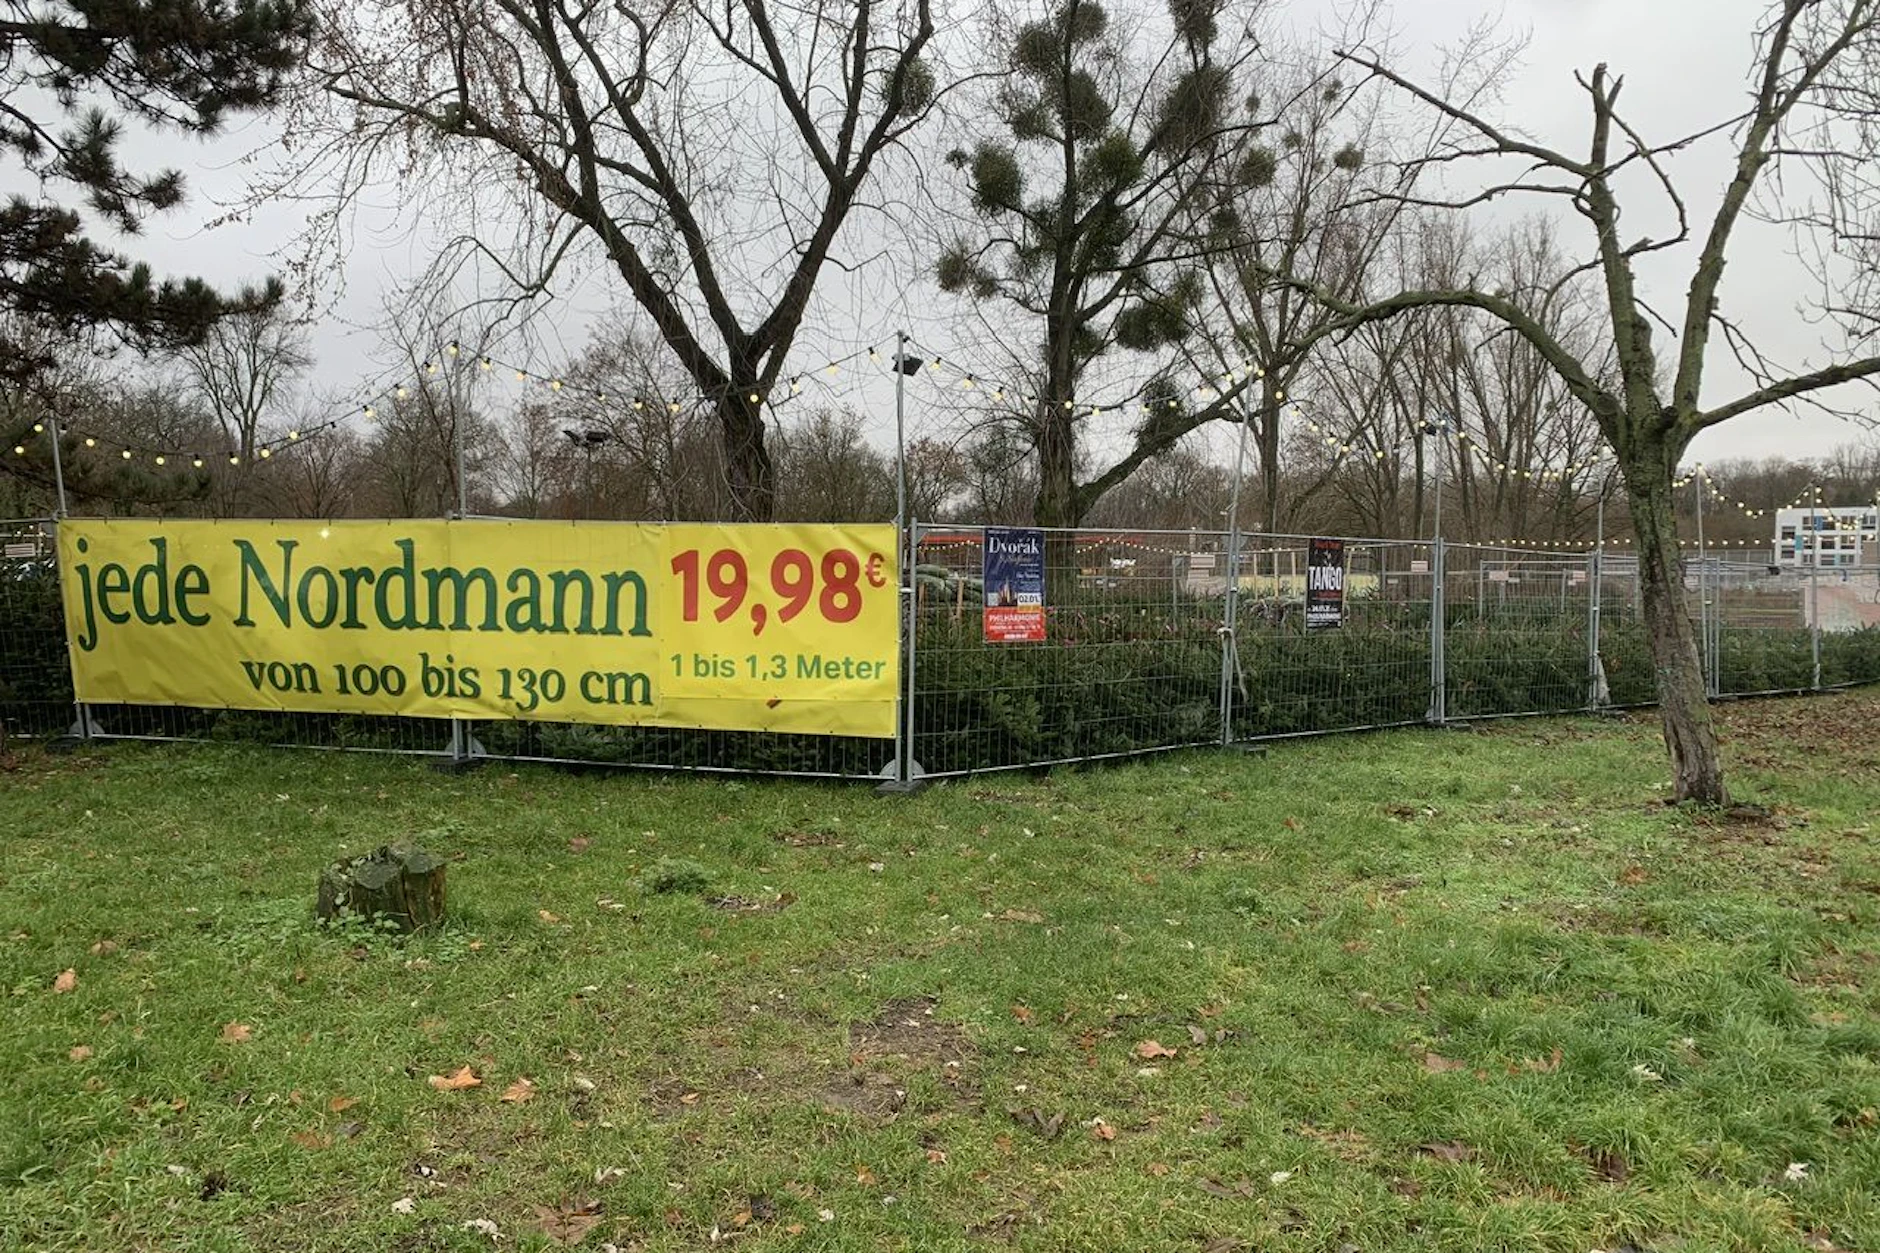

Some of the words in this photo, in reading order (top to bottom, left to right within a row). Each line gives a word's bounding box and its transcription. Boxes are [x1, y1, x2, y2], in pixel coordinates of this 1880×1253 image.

[989, 536, 1040, 555] Dvořák
[1308, 565, 1343, 590] TANGO
[74, 537, 212, 652] jede
[233, 538, 653, 638] Nordmann
[239, 660, 323, 695] von
[336, 663, 407, 697] 100
[419, 652, 482, 700] bis
[497, 667, 567, 712] 130
[579, 668, 654, 707] cm
[670, 654, 682, 678] 1
[693, 653, 735, 679] bis
[745, 655, 788, 682] 1,3
[796, 655, 887, 681] Meter
